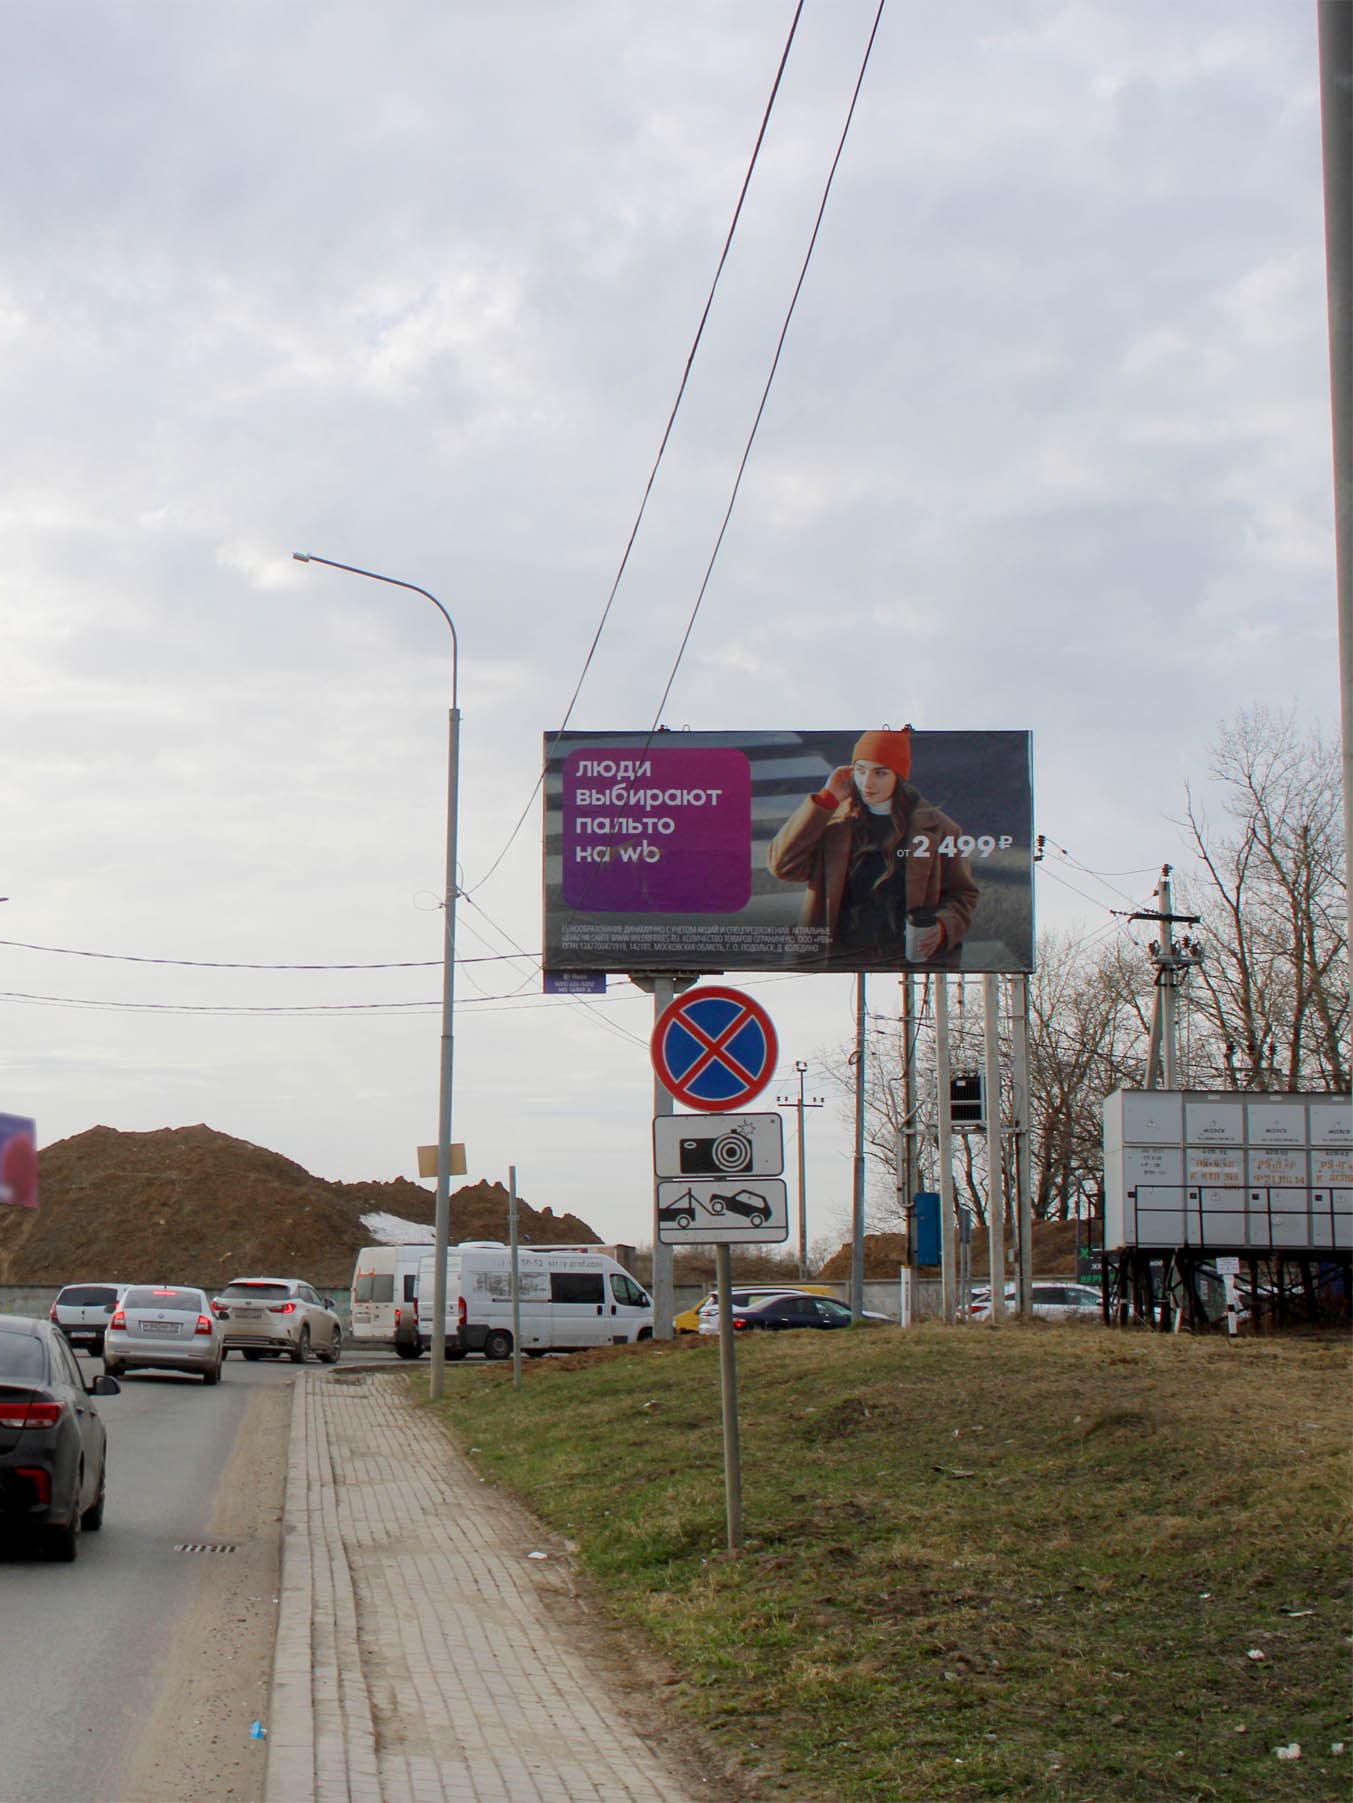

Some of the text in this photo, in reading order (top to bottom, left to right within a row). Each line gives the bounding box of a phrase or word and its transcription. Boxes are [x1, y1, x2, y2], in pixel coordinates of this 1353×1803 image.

[576, 760, 651, 781] люди
[576, 783, 723, 811] выбирают
[576, 817, 675, 834] пальто
[576, 840, 661, 863] на wb
